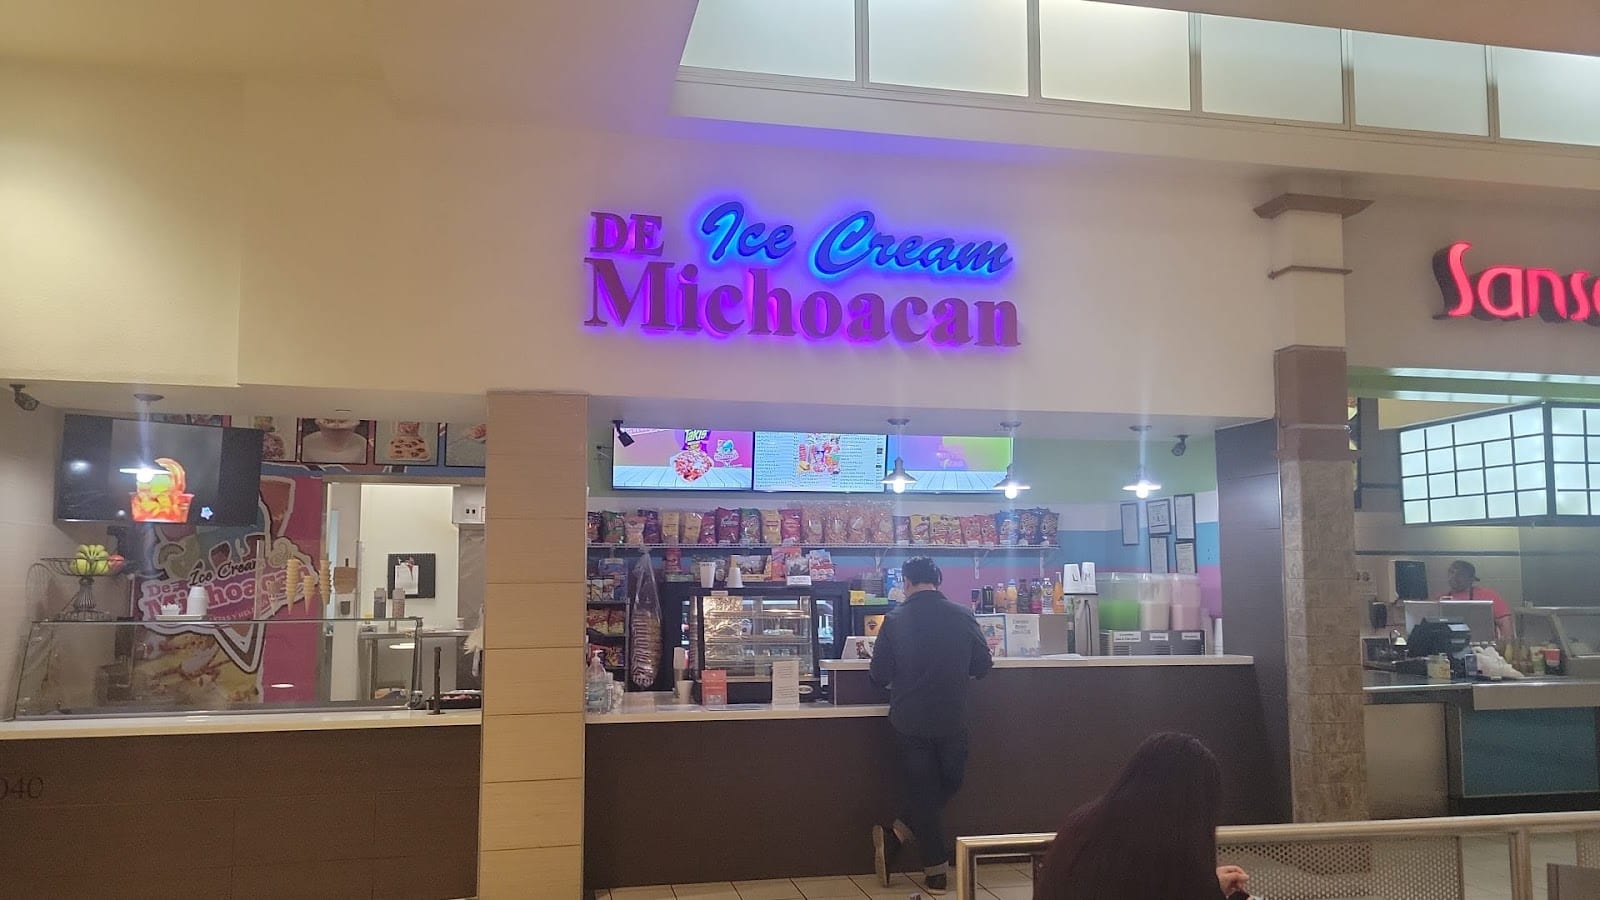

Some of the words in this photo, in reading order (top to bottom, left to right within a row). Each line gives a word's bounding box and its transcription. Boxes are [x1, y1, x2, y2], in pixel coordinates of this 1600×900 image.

[590, 211, 664, 256] DE
[701, 201, 796, 261] Ice
[814, 210, 1013, 275] Cream
[584, 257, 1022, 347] Michoacan
[1446, 239, 1600, 323] Sans
